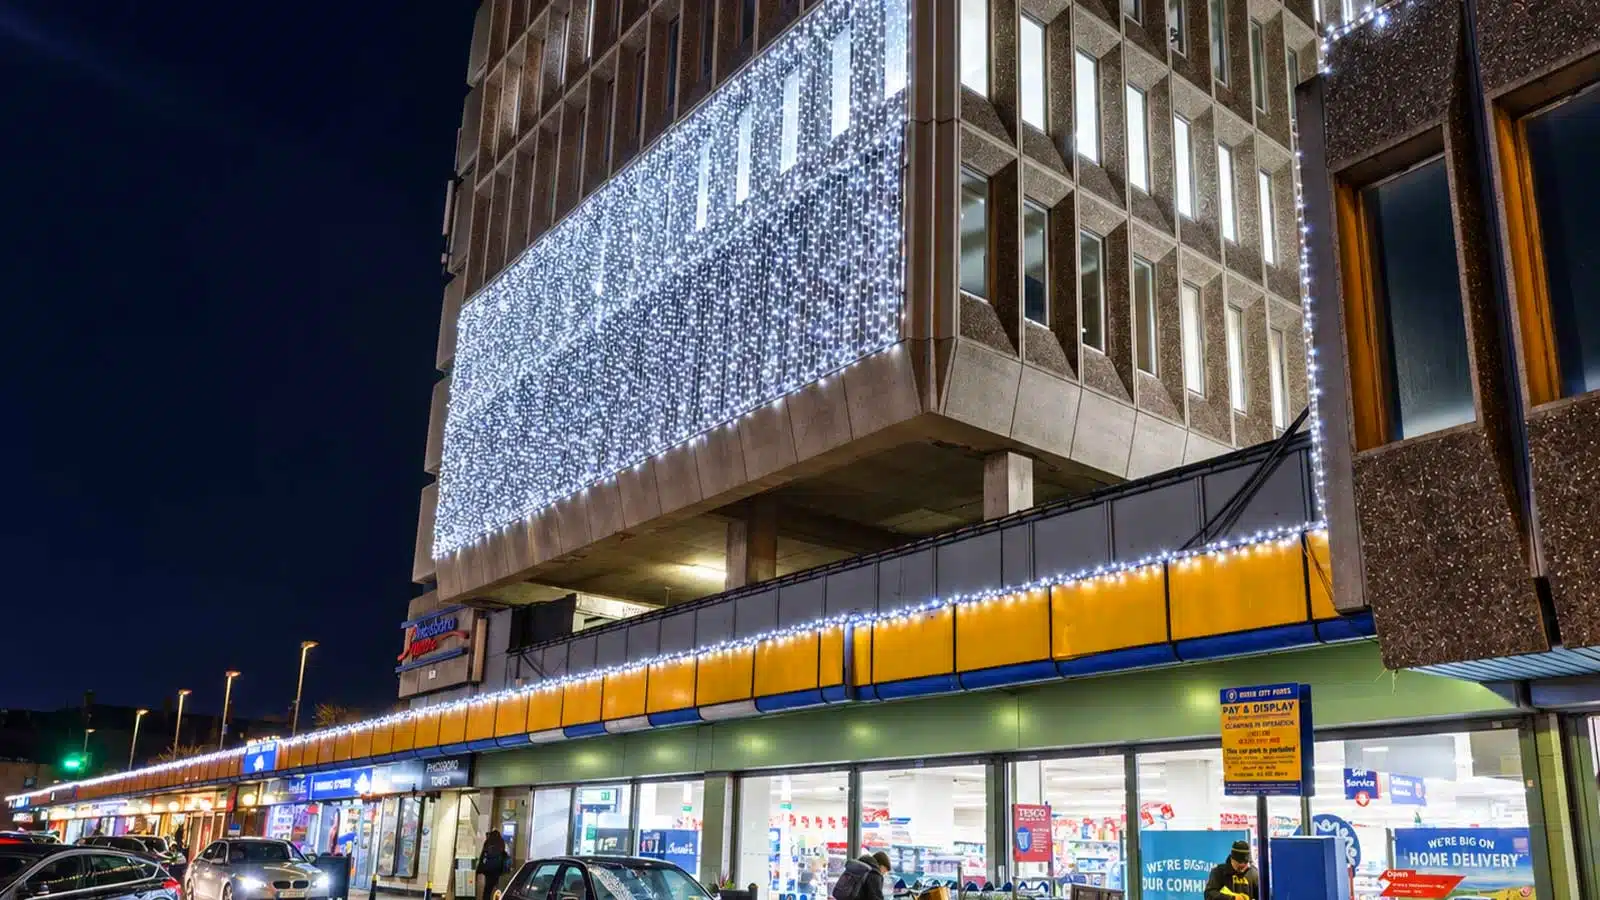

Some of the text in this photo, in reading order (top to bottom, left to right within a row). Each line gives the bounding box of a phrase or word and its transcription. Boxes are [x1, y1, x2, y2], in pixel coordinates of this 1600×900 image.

[1223, 702, 1295, 714] PAY & DISPLAY
[1018, 808, 1046, 818] TESCO
[1459, 836, 1476, 847] BIG
[1479, 838, 1495, 849] ON
[1409, 852, 1448, 866] HOME
[1146, 859, 1181, 874] WE'RE
[1386, 870, 1408, 880] Open
